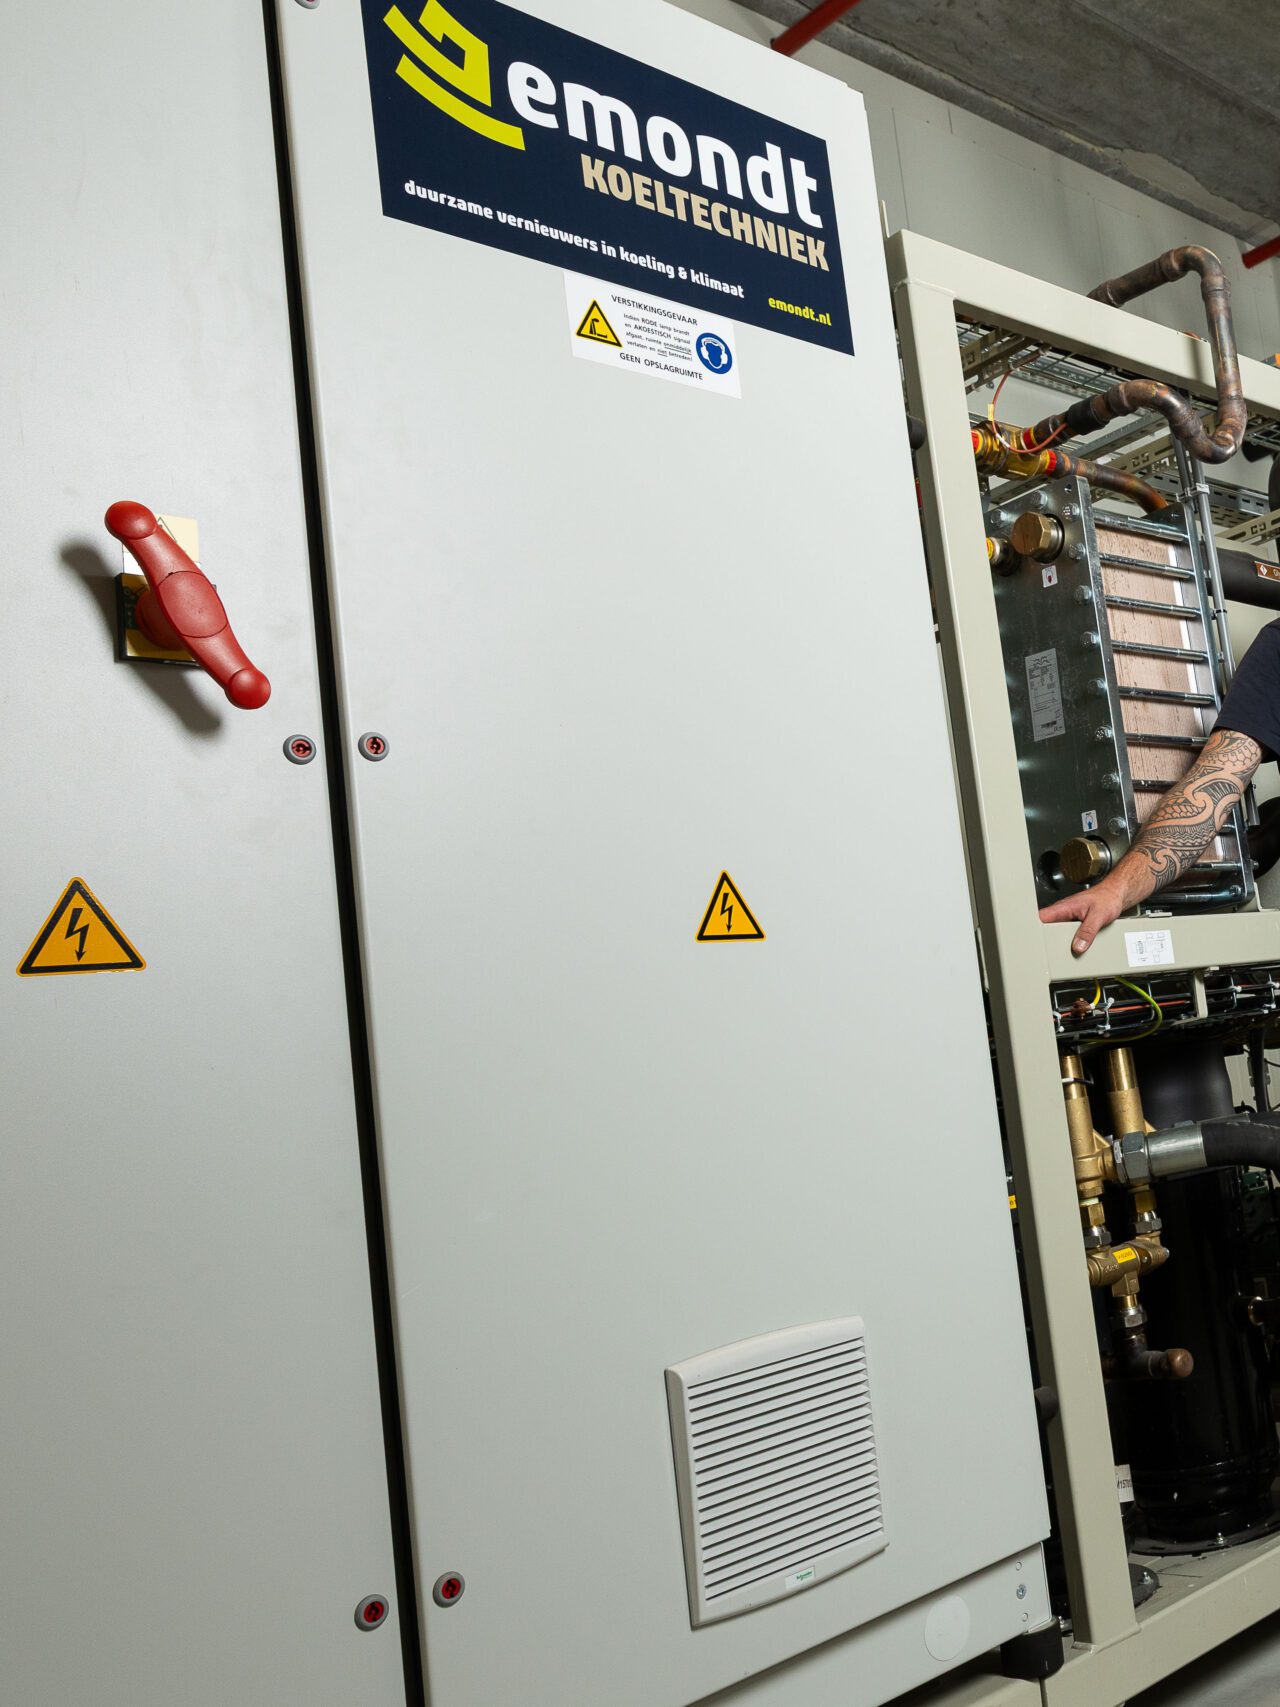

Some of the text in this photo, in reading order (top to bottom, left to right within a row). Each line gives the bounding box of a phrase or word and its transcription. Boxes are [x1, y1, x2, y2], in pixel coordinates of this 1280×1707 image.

[507, 61, 824, 229] emondt
[580, 153, 830, 272] KOELTECHNIEK
[404, 180, 745, 298] duurzame vernieuwers in koeling & klimaat
[611, 294, 698, 326] VERSTIKKINGSGEVAAR
[641, 317, 658, 328] RODE
[768, 297, 832, 326] emondt.nl
[633, 324, 672, 340] AKOESTISCH
[620, 352, 703, 380] GEEN OPSLAGRUIMTE
